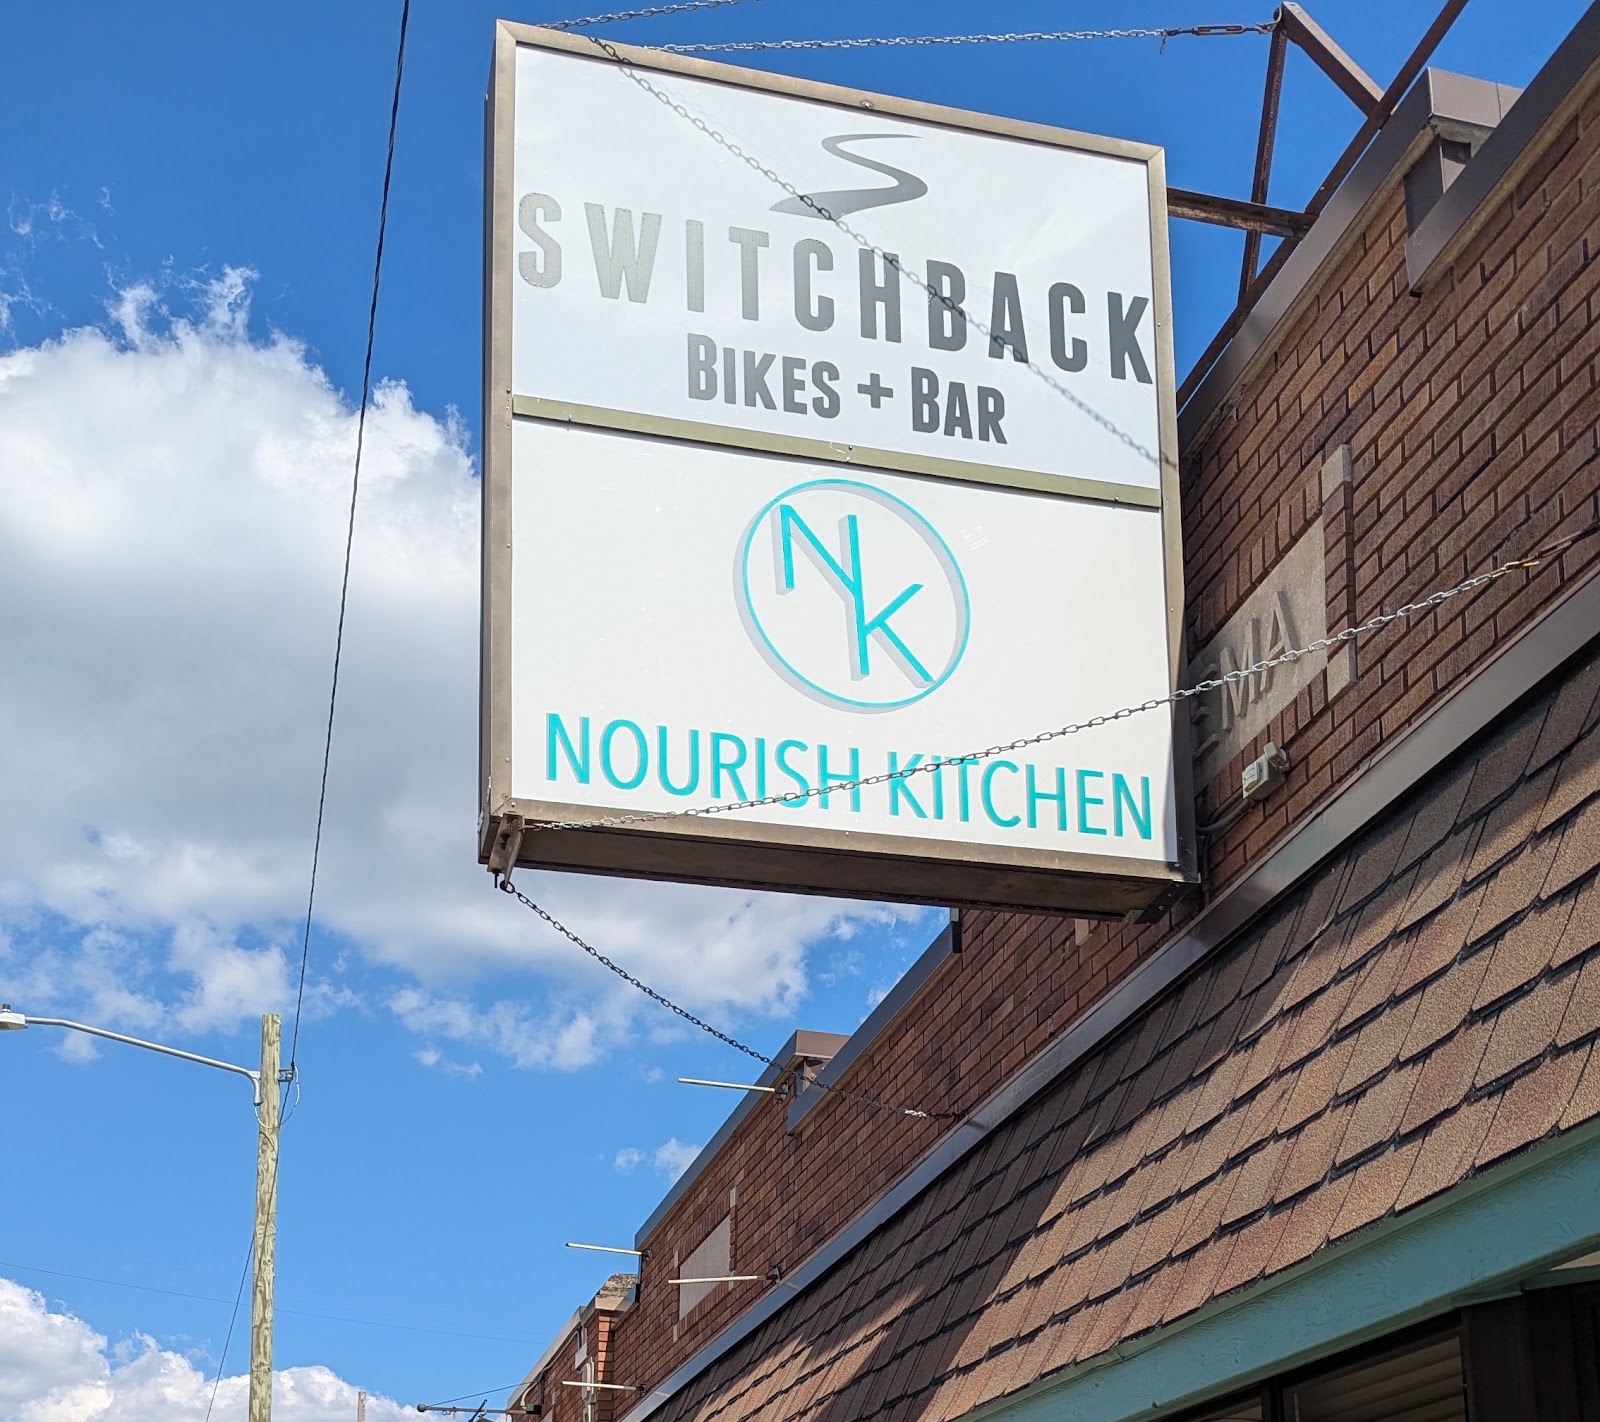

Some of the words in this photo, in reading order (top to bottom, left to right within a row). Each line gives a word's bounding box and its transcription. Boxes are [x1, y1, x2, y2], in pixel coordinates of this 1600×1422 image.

[517, 190, 1155, 385] SWITCHBACK
[687, 333, 841, 420] BIKES
[857, 372, 895, 410] +
[911, 367, 1009, 445] BAR
[545, 710, 860, 812] NOURISH
[886, 750, 1152, 840] KITCHEN
